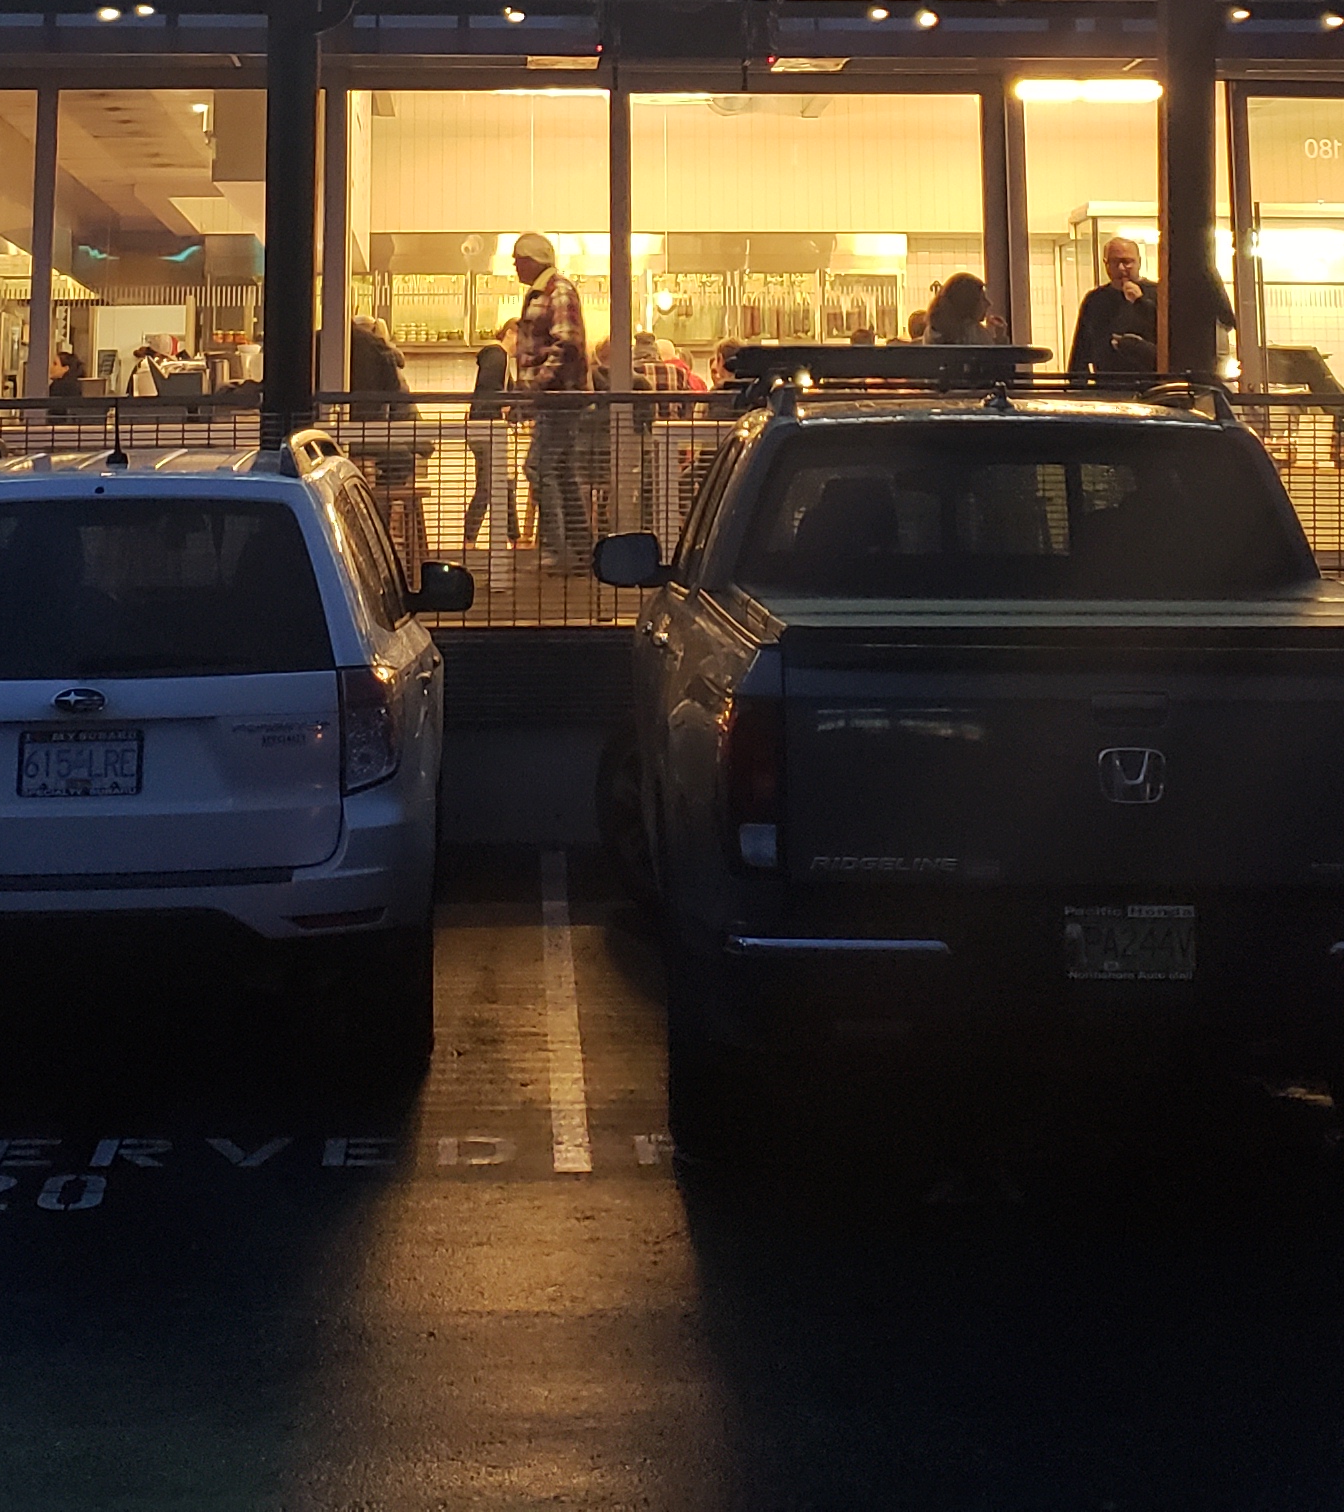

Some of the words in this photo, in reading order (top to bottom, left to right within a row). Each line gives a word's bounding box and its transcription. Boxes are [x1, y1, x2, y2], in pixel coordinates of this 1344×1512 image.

[809, 856, 959, 872] RIDGELINE
[1063, 905, 1123, 916] Pacific
[1130, 905, 1194, 917] Honda
